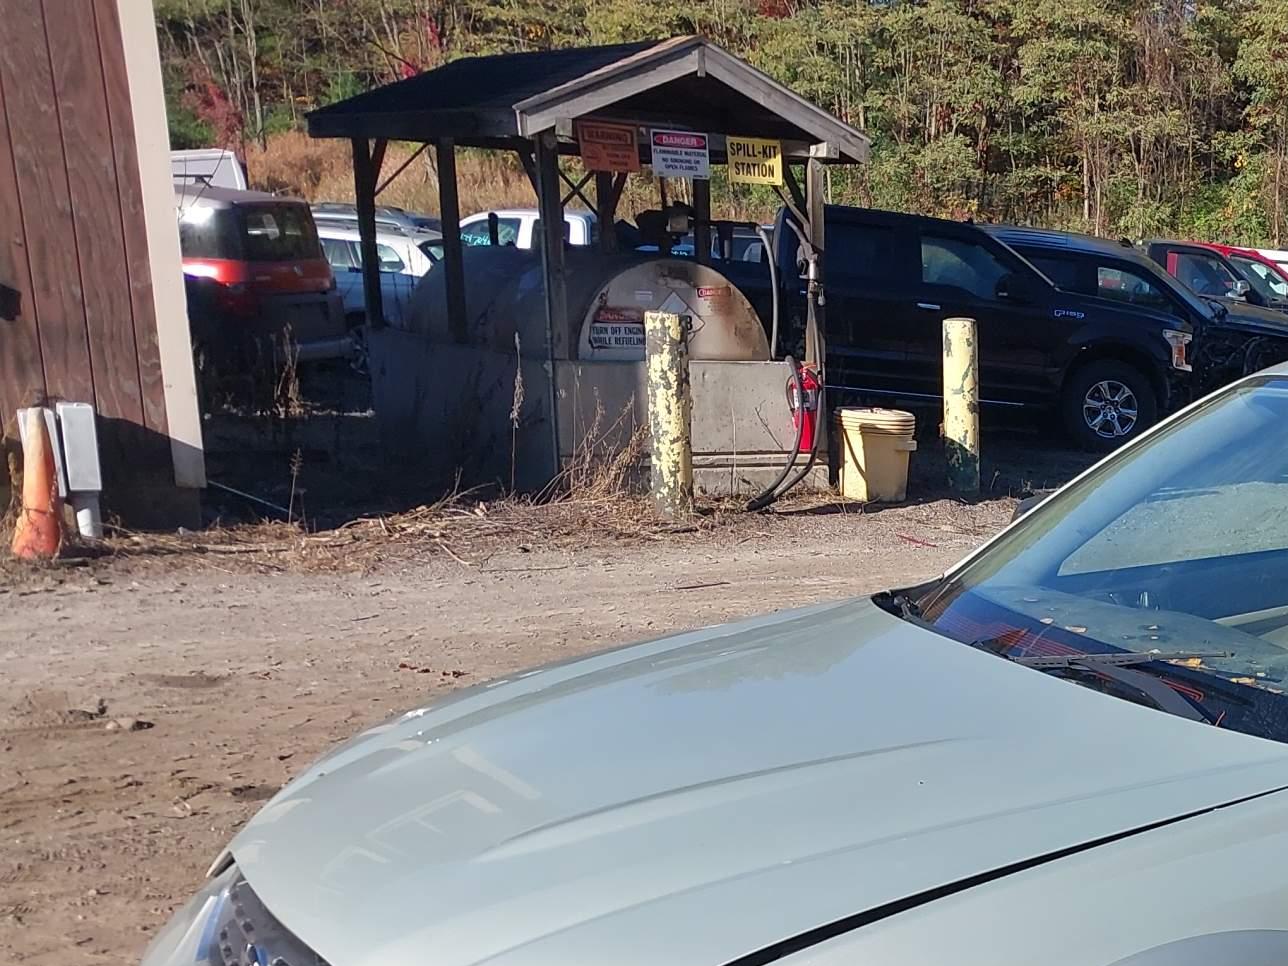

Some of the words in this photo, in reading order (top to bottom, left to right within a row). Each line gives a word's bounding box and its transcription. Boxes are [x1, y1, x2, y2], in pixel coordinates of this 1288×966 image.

[662, 135, 698, 148] DANGER
[730, 142, 777, 159] SPILL-KIT
[735, 161, 775, 178] STATION
[611, 326, 622, 335] OFF
